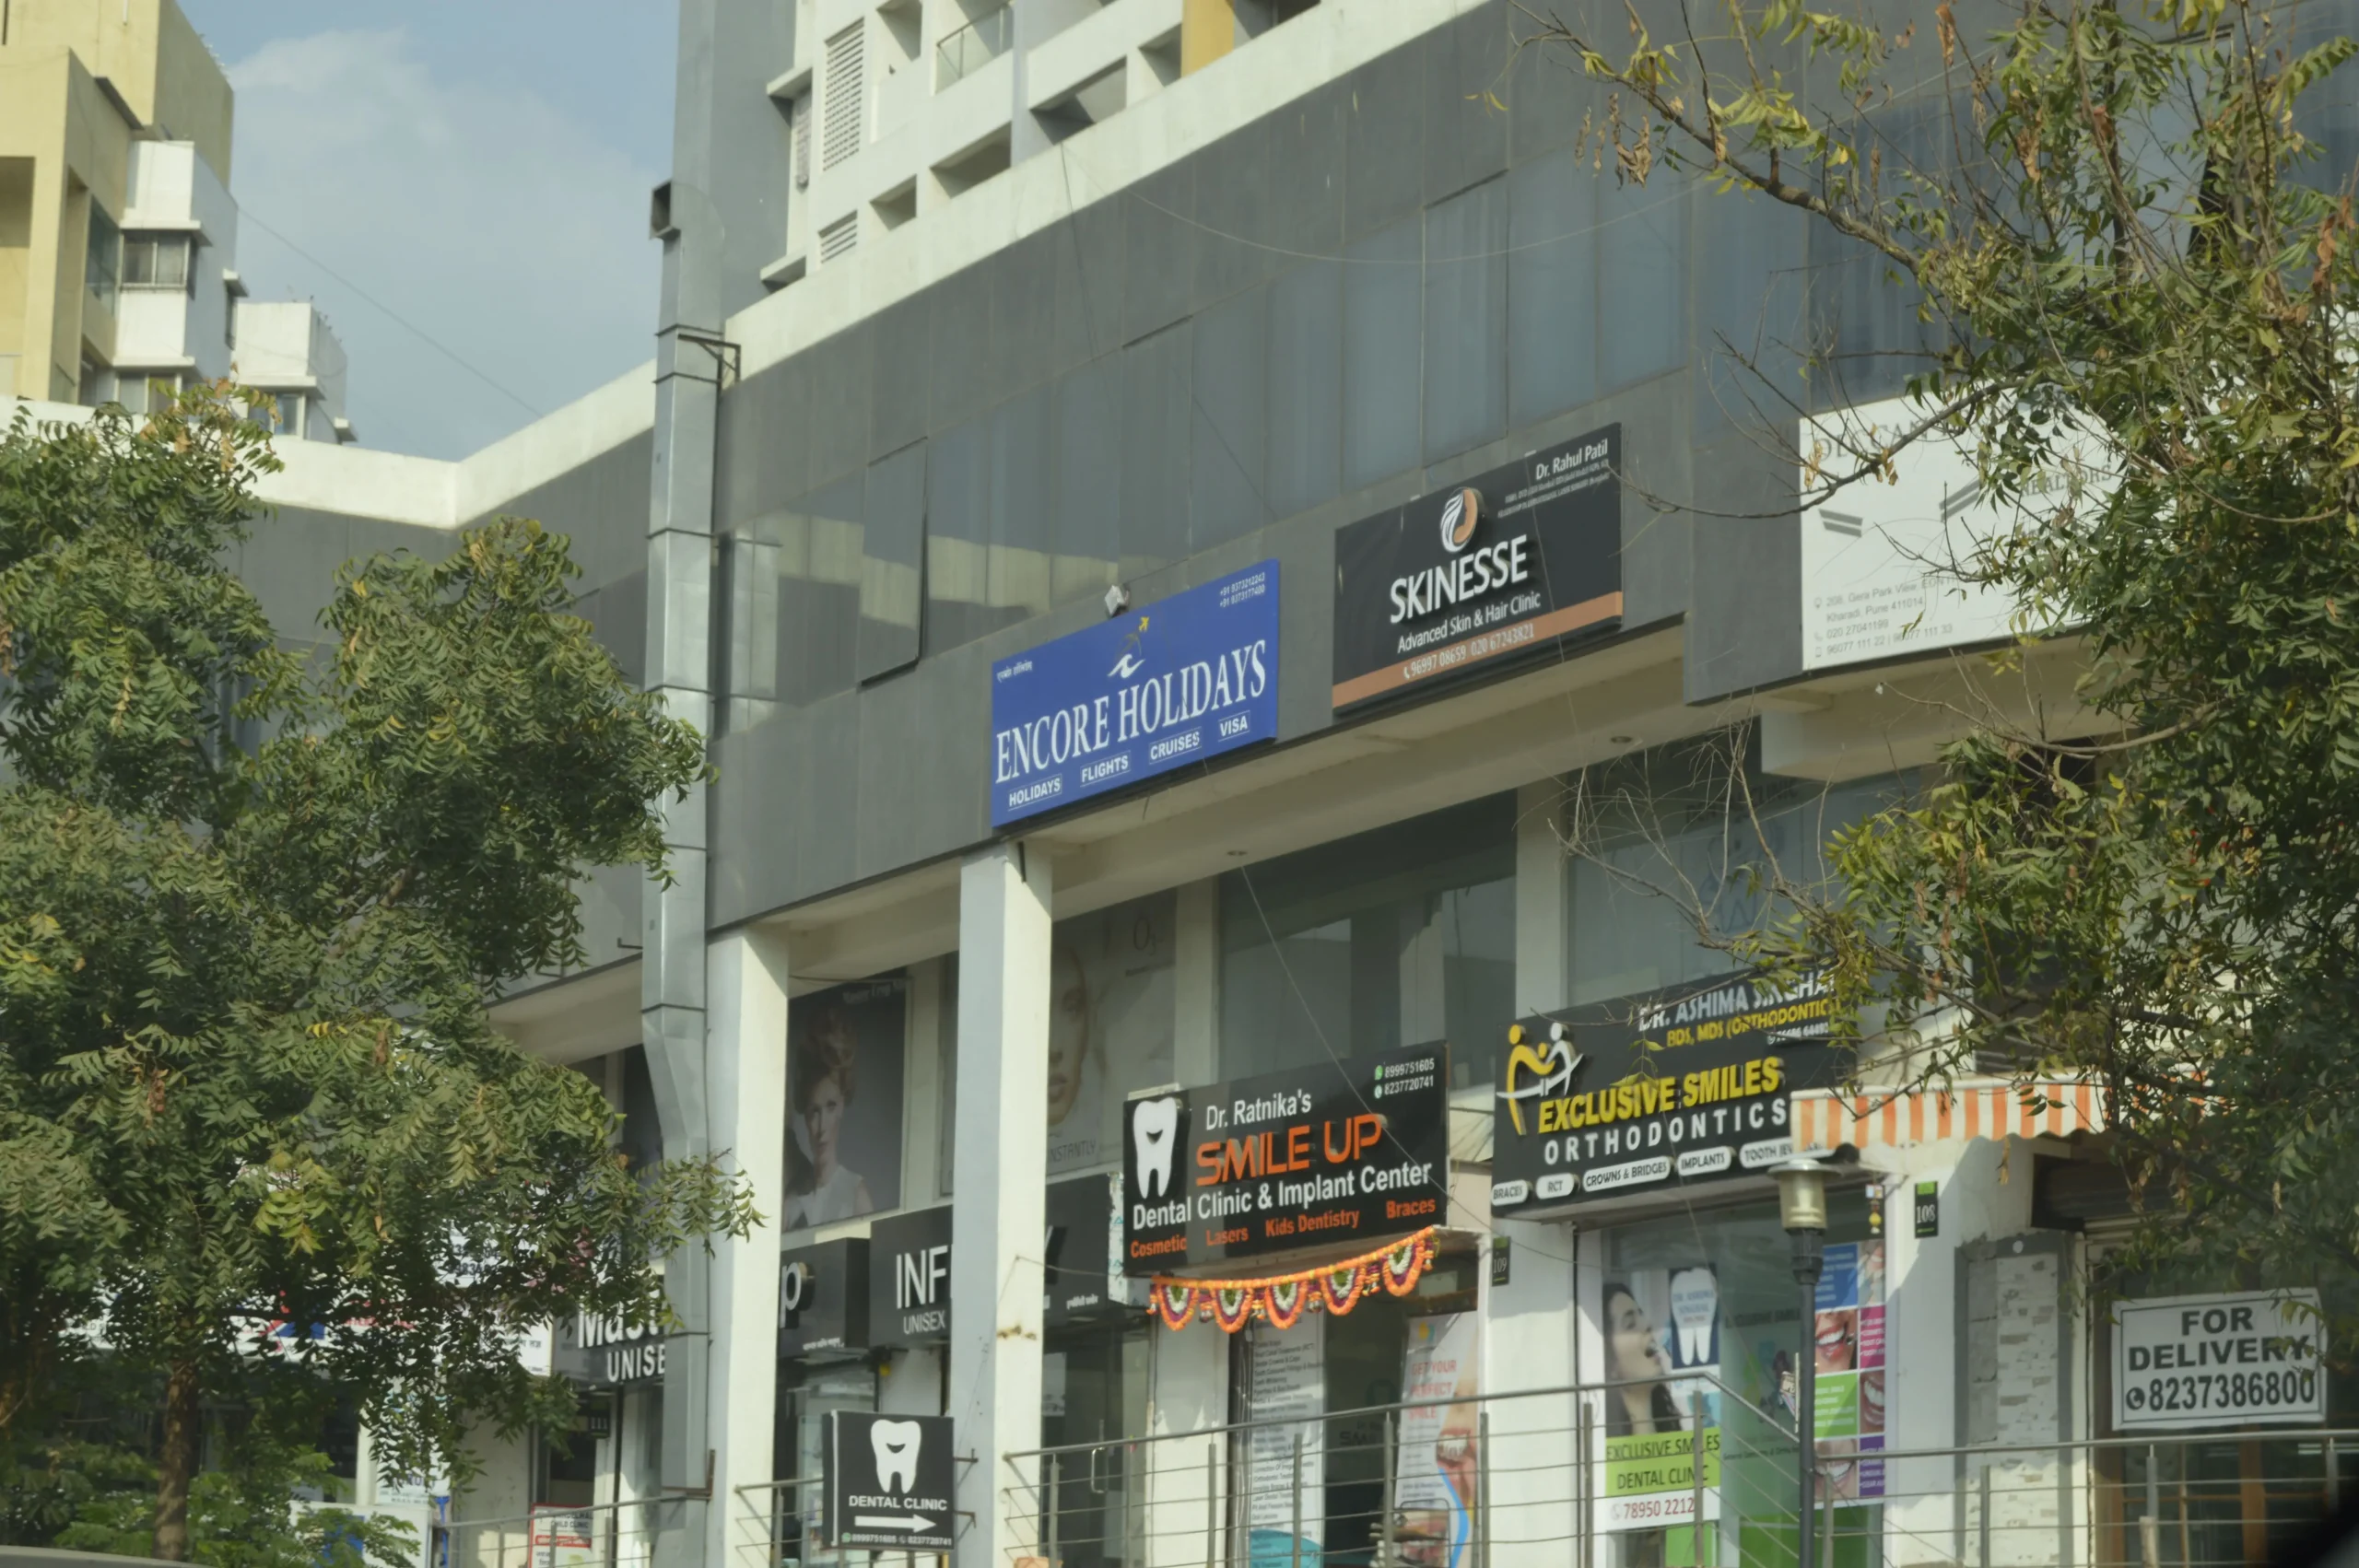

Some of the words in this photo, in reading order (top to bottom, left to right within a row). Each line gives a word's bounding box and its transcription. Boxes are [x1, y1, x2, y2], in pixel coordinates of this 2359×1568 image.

[1535, 462, 1550, 481] Dr.
[1553, 448, 1583, 474] Rahul
[1585, 438, 1608, 462] Patil
[1390, 534, 1528, 624] SKINESSE
[1397, 619, 1448, 654] Advanced
[1449, 614, 1472, 636] Skin
[1473, 608, 1484, 627] &
[1485, 602, 1508, 624] Hair
[1510, 591, 1541, 615] Clinic
[1865, 603, 1889, 615] Pune
[995, 696, 1110, 784] ENCORE
[1117, 639, 1266, 743] HOLIDAYS
[1009, 777, 1061, 807] HOLIDAYS
[1081, 755, 1129, 783] FLIGHTS
[1150, 731, 1200, 760] CRUISES
[1219, 715, 1249, 737] VISA
[1674, 985, 1750, 1024] ASHIMA
[1697, 1020, 1724, 1042] MDS
[1384, 1074, 1434, 1095] 8237720741
[1538, 1076, 1676, 1134] EXCLUSIVE
[1683, 1056, 1782, 1106] SMILES
[1205, 1105, 1228, 1130] Dr.
[1234, 1089, 1312, 1126] Ratnika's
[1544, 1097, 1787, 1165] ORTHODONTICS
[1195, 1124, 1310, 1187] SMILE
[1323, 1113, 1384, 1164] UP
[1681, 1153, 1725, 1169] IMPLANTS
[1547, 1180, 1563, 1193] RCT
[1586, 1171, 1621, 1187] CROWNS
[1623, 1168, 1630, 1179] &
[1632, 1162, 1667, 1178] BRIDGES
[1133, 1200, 1192, 1230] Dental
[1198, 1189, 1252, 1219] Clinic
[1258, 1183, 1273, 1210] &
[1279, 1169, 1355, 1209] Implant
[1360, 1162, 1433, 1193] Center
[1493, 1185, 1523, 1200] BRACES
[1131, 1234, 1187, 1258] Cosmetic
[1205, 1225, 1250, 1246] Lasers
[1265, 1215, 1295, 1237] Kids
[1297, 1209, 1360, 1234] Dentistry
[1386, 1199, 1436, 1219] Braces
[1917, 1204, 1935, 1223] 108
[1493, 1257, 1508, 1273] 109
[903, 1310, 945, 1335] UNISEX
[2181, 1306, 2253, 1336] FOR
[607, 1343, 665, 1382] UNISE
[1431, 1359, 1457, 1373] YOUR
[2129, 1335, 2309, 1371] DELIVERY
[2149, 1369, 2316, 1411] 8237386800
[1606, 1439, 1672, 1461] EXCLUSIVE
[1675, 1433, 1720, 1453] SMES
[1618, 1469, 1665, 1490] DENTAL
[1669, 1465, 1708, 1484] CLIN
[848, 1495, 900, 1508] DENTAL
[903, 1497, 947, 1511] CLINIC
[1624, 1500, 1661, 1519] 78950
[1664, 1497, 1696, 1515] 2212
